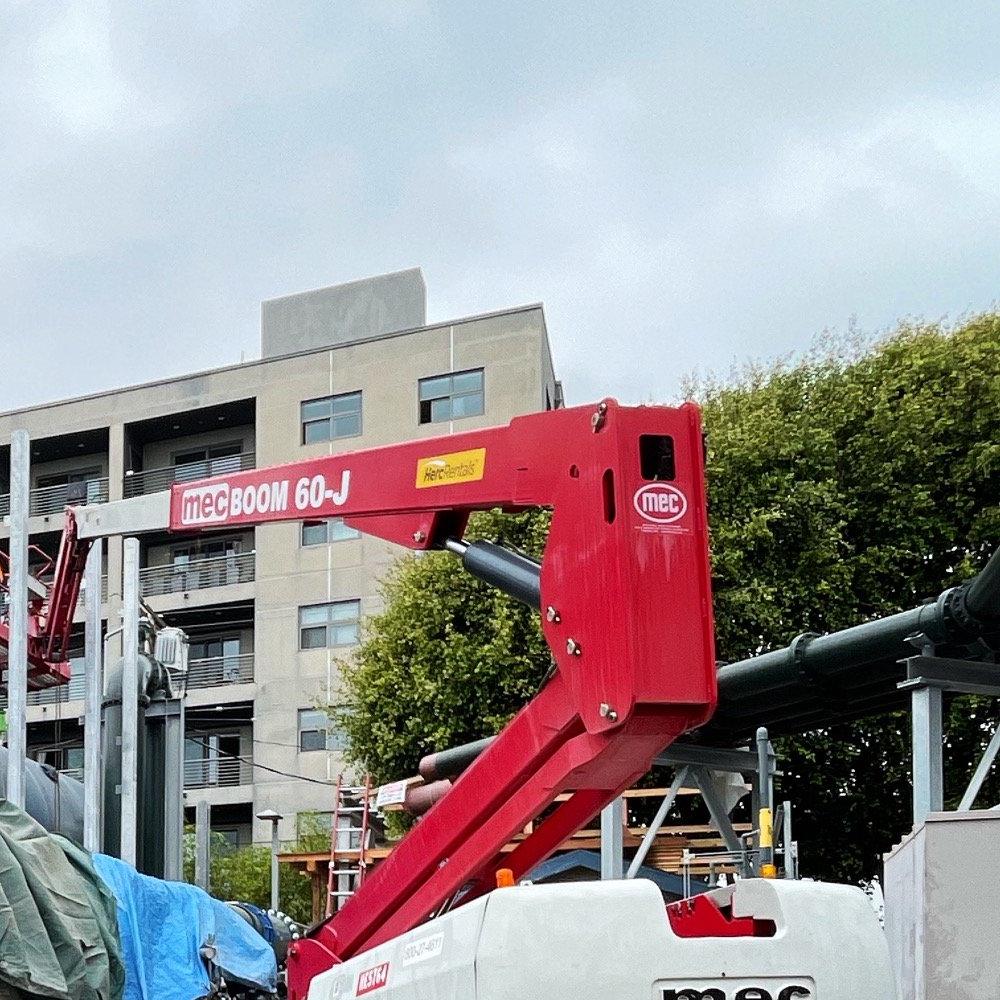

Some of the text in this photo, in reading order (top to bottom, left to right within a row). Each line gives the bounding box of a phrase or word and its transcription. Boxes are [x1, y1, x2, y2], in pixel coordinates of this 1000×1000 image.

[183, 470, 351, 520] mec BOOM 60-J
[642, 492, 680, 513] mec
